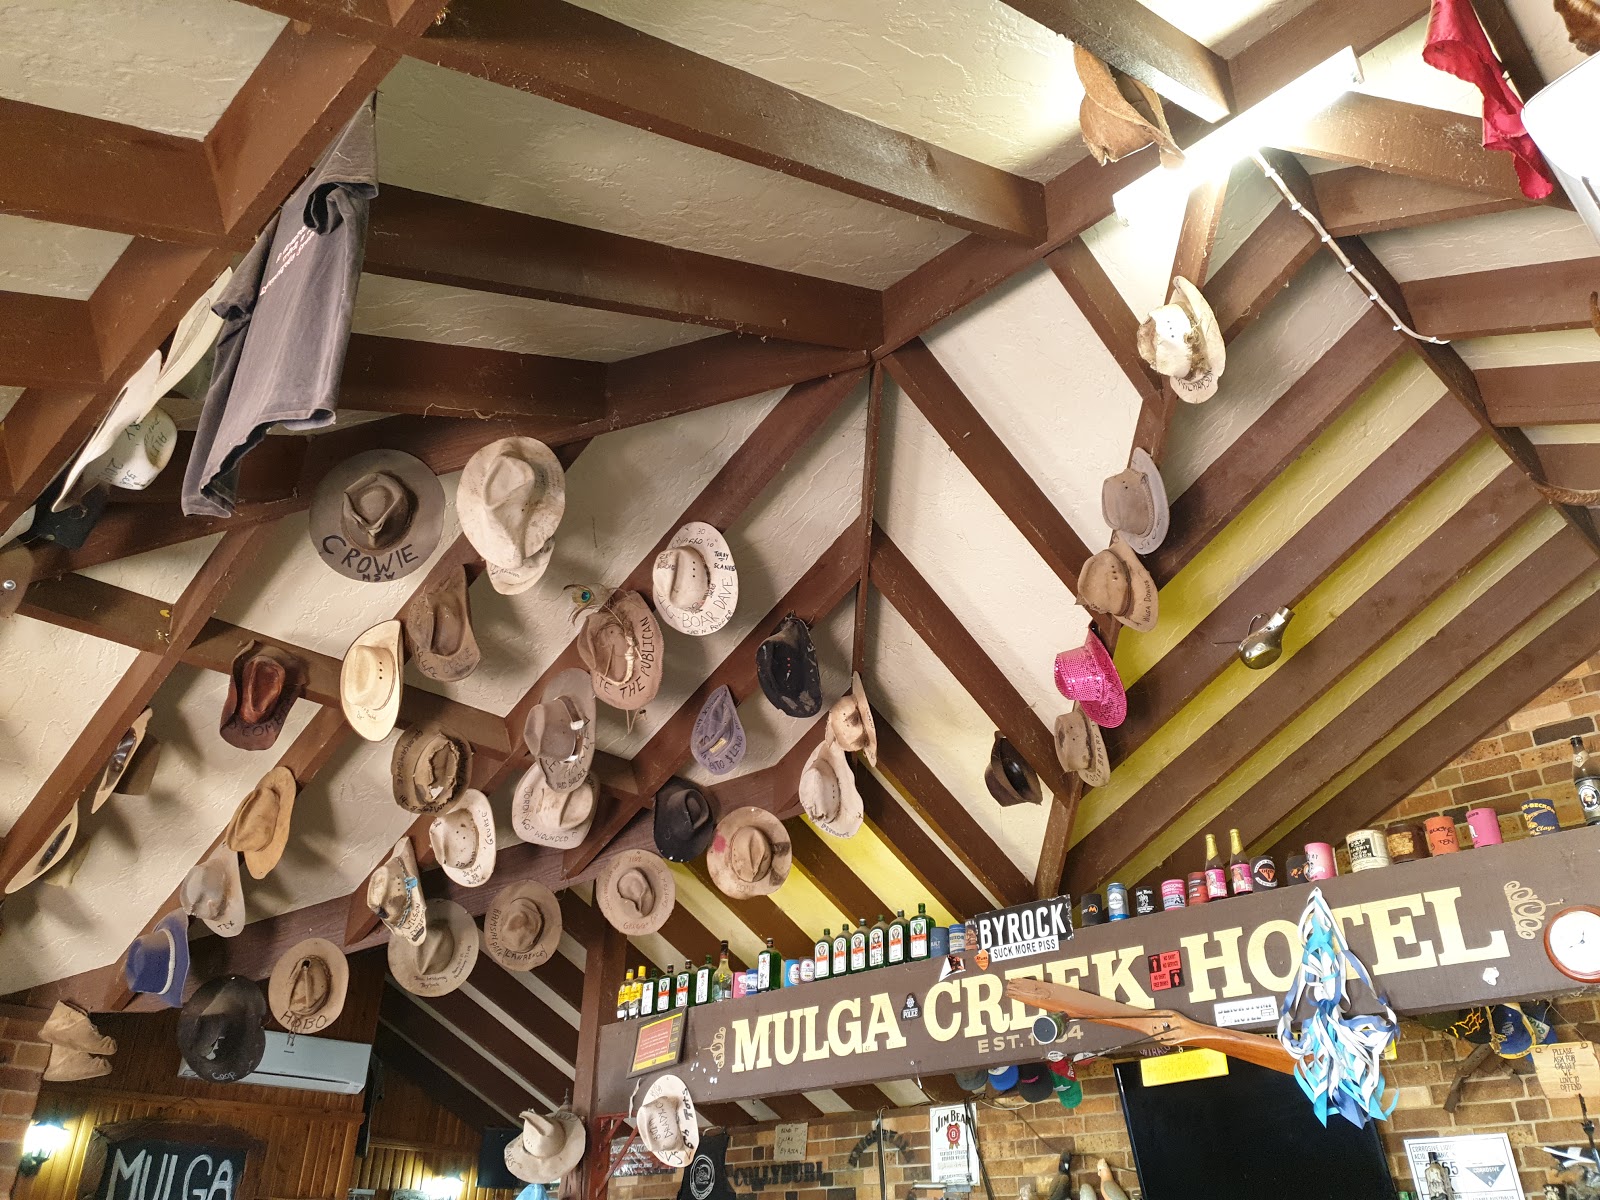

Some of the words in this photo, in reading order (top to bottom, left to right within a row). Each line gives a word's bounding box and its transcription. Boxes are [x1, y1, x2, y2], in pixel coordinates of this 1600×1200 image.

[322, 534, 419, 574] CROWIE
[362, 571, 396, 582] NSW
[682, 611, 720, 628] BOAR
[713, 576, 733, 610] DAVE
[619, 676, 646, 700] THE
[640, 616, 655, 678] PUBLICAN
[217, 920, 235, 931] TEX
[978, 902, 1067, 950] BYROCK
[993, 946, 1014, 959] SUCK
[1015, 942, 1037, 954] MORE
[1038, 938, 1056, 950] PISS
[280, 1010, 327, 1030] HOBO
[902, 1009, 919, 1019] POLICE
[731, 992, 907, 1073] MULGA
[978, 1034, 1024, 1054] EST.
[935, 1113, 949, 1133] JIM
[106, 1148, 234, 1200] MULGA
